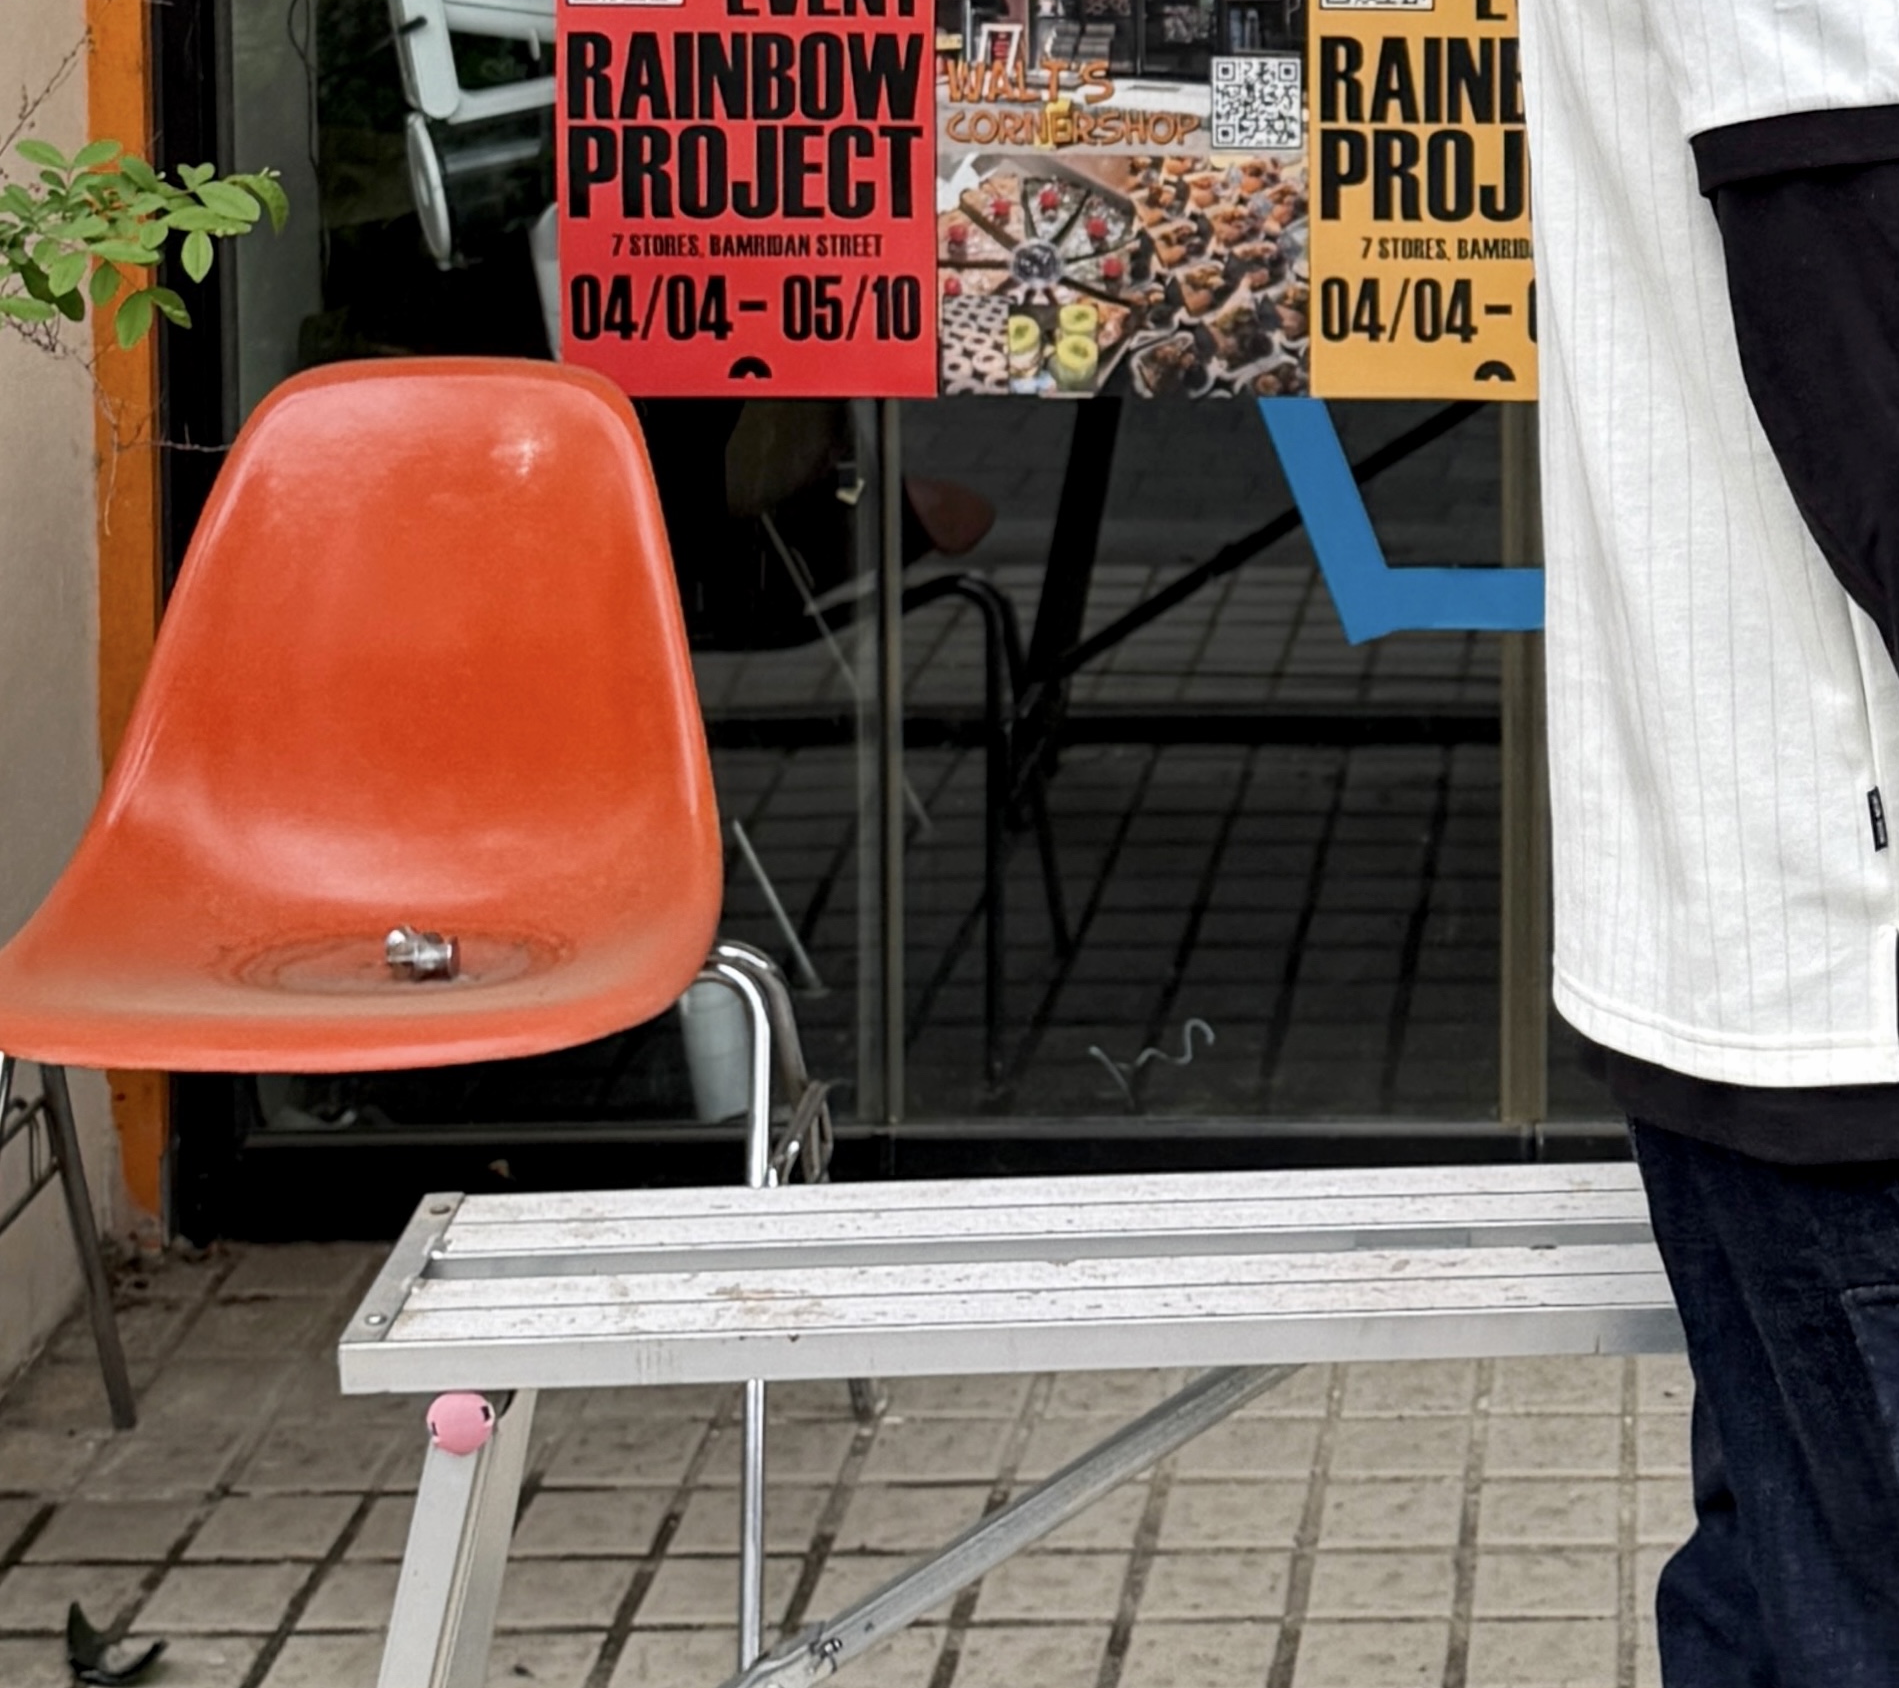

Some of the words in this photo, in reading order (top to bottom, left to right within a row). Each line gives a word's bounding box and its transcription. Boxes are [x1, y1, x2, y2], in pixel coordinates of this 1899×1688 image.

[566, 31, 924, 121] RAINBOW
[946, 59, 1116, 104] WALT'S
[945, 110, 1202, 145] CORNERSHOP
[567, 124, 923, 220] PROJECT
[1320, 129, 1532, 221] PROJ
[612, 233, 624, 257] 7
[629, 234, 705, 258] STORES,
[709, 234, 810, 257] BAMRIDAN
[816, 234, 882, 258] STREET
[1361, 236, 1373, 259] 7
